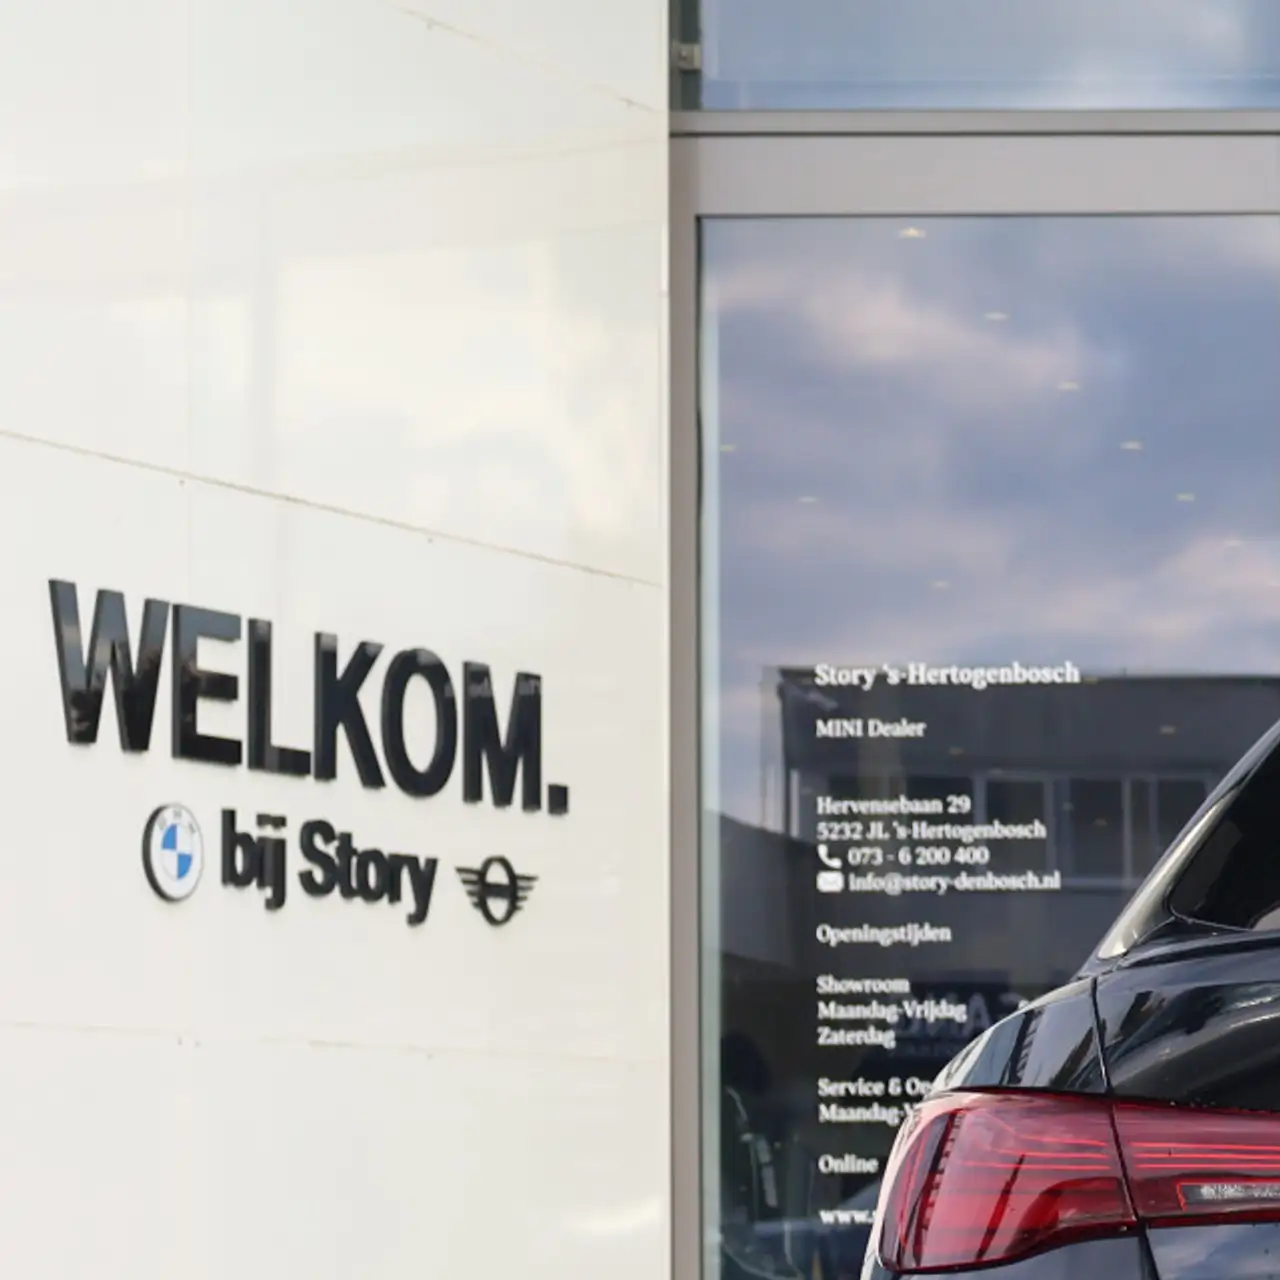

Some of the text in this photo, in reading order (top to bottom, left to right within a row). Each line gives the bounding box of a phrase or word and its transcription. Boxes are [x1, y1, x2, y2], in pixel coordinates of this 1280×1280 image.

[815, 662, 1081, 691] Story 's-Hertogenbosch
[48, 578, 569, 815] WELKOM.
[816, 718, 927, 737] MINI Dealer
[816, 794, 971, 815] Hervensebaan 29
[816, 821, 862, 840] 5232
[866, 821, 890, 840] JL
[847, 847, 883, 866] 073
[898, 846, 912, 865] 6
[915, 846, 950, 865] 200
[954, 846, 990, 865] 400
[221, 808, 439, 927] bij Story
[849, 870, 1062, 895] info@story-denbosch.nl
[816, 924, 952, 946] Openingstijden
[816, 975, 910, 994] Showroom
[816, 1000, 968, 1023] Maandag-Vrijdag
[817, 1026, 897, 1048] Zaterdag
[818, 1077, 885, 1096] Service
[888, 1077, 902, 1095] &
[818, 1154, 879, 1173] Online
[818, 1209, 876, 1225] www.
